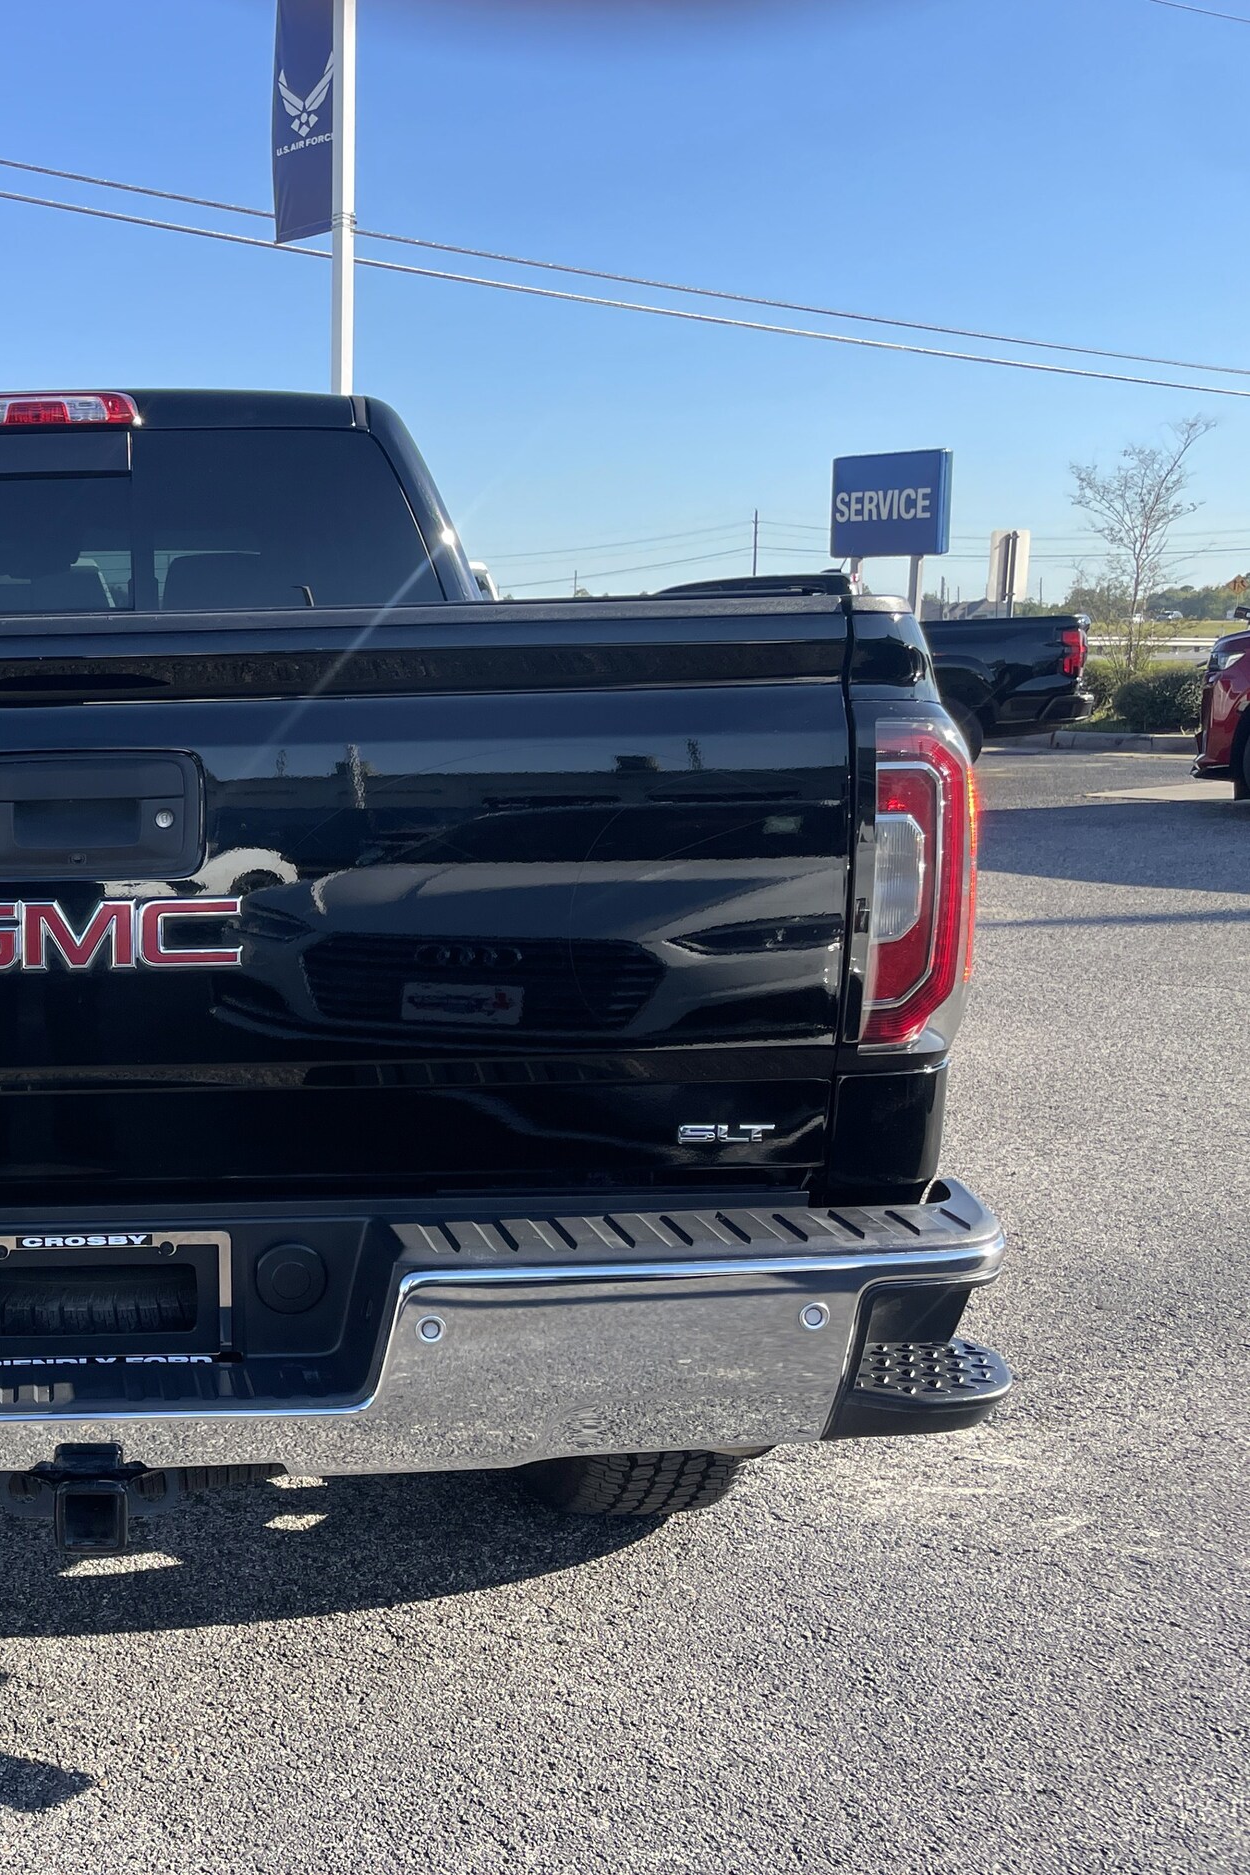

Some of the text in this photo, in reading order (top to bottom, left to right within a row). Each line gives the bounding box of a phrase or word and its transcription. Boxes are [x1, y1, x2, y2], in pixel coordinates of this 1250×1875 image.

[276, 132, 334, 157] U.S. AIR FORC
[835, 487, 931, 523] SERVICE
[677, 1124, 776, 1144] SLT
[21, 1234, 148, 1248] CROSBY
